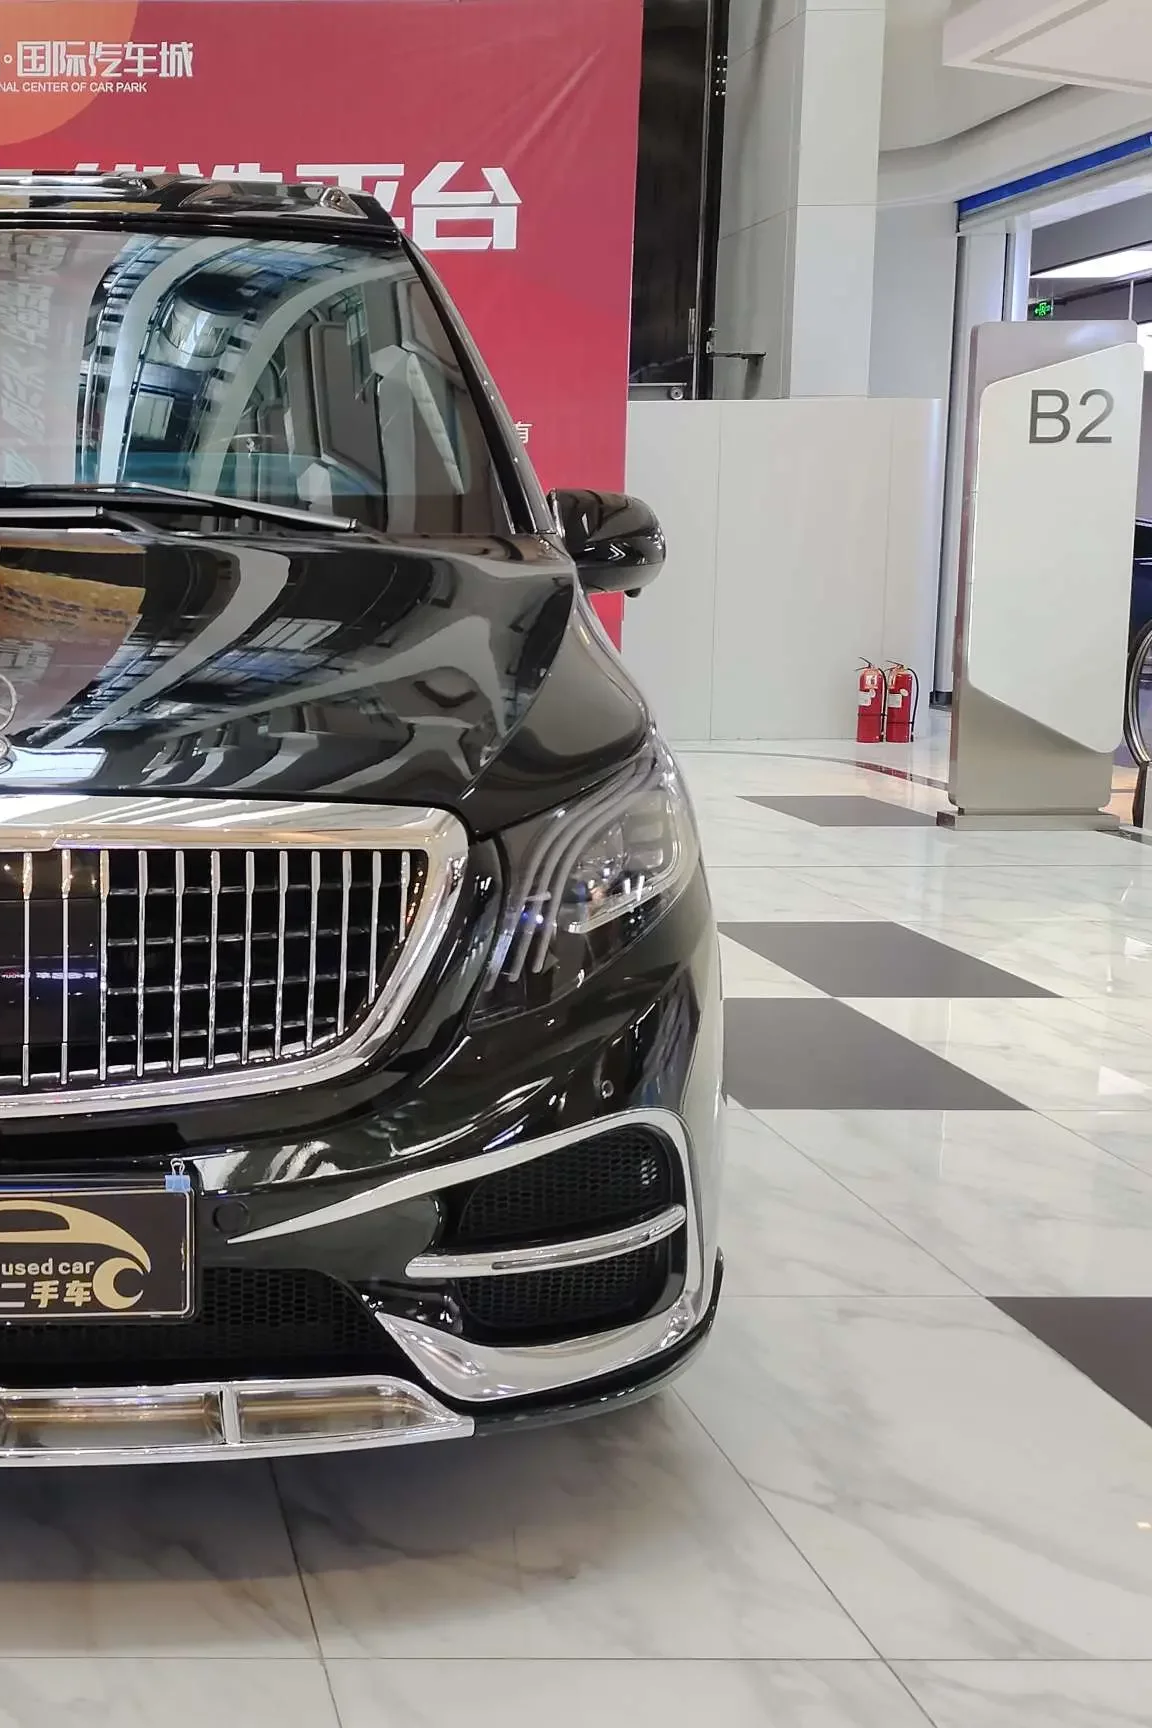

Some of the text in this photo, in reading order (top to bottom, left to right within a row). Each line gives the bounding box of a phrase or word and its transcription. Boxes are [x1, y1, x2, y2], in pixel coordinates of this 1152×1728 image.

[22, 81, 68, 93] CENTER
[71, 81, 87, 93] OF
[90, 81, 113, 93] CAR
[116, 81, 148, 93] PARK
[1029, 388, 1115, 444] B2
[0, 1257, 96, 1277] used car
